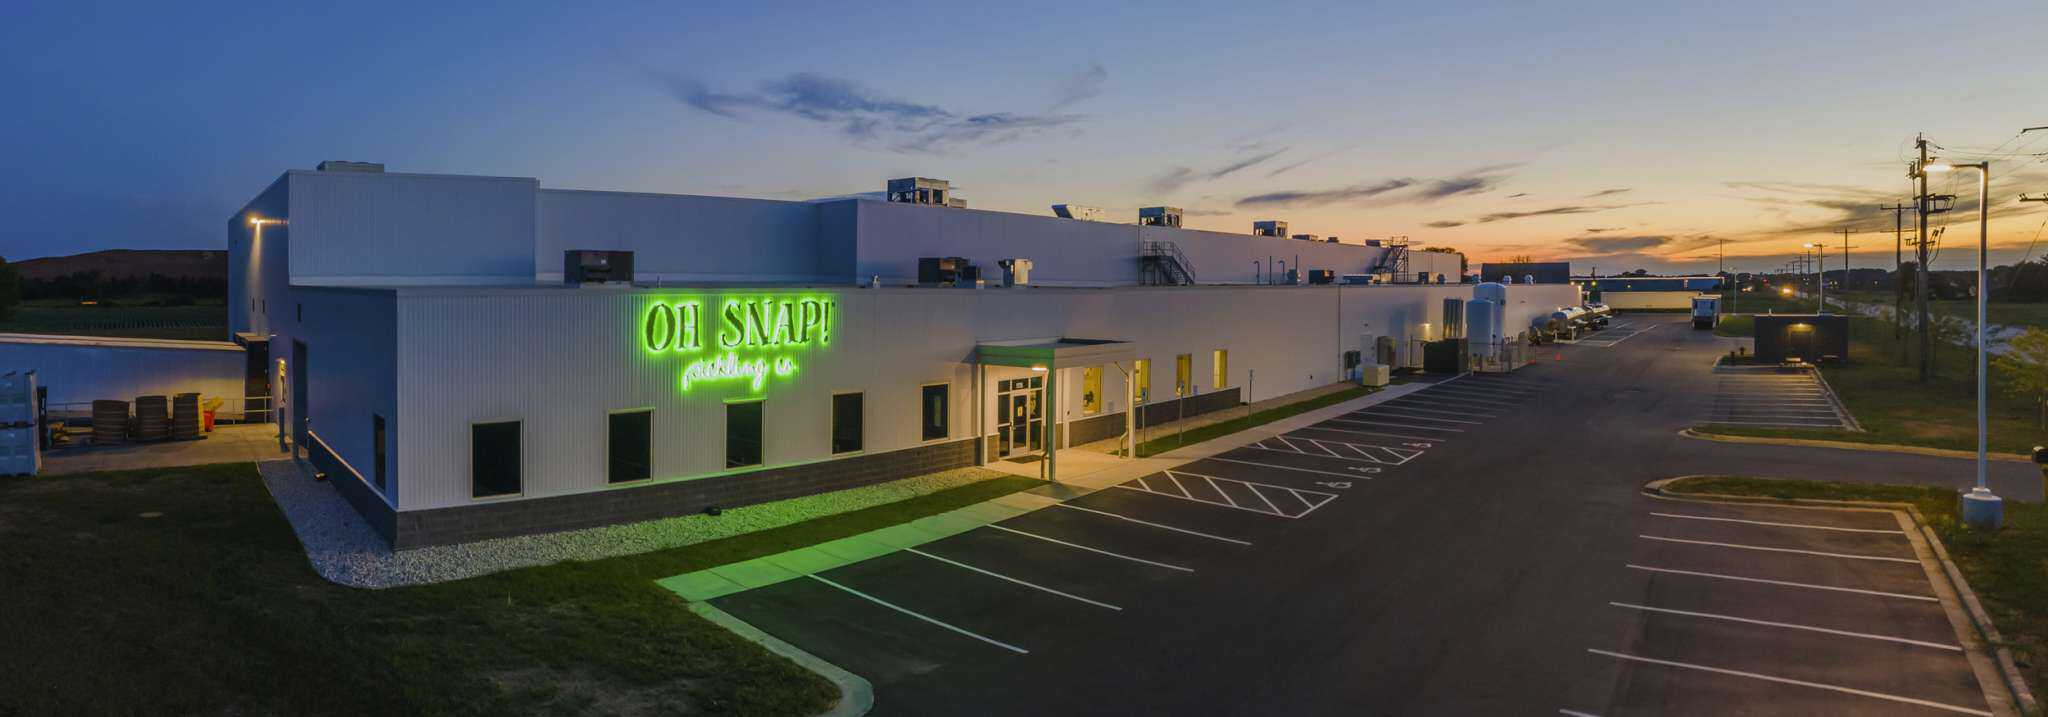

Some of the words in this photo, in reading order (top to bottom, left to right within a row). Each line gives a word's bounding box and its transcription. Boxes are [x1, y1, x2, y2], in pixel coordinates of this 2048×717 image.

[645, 302, 702, 352] OH
[721, 298, 832, 348] SNAP!
[682, 352, 767, 390] pickling
